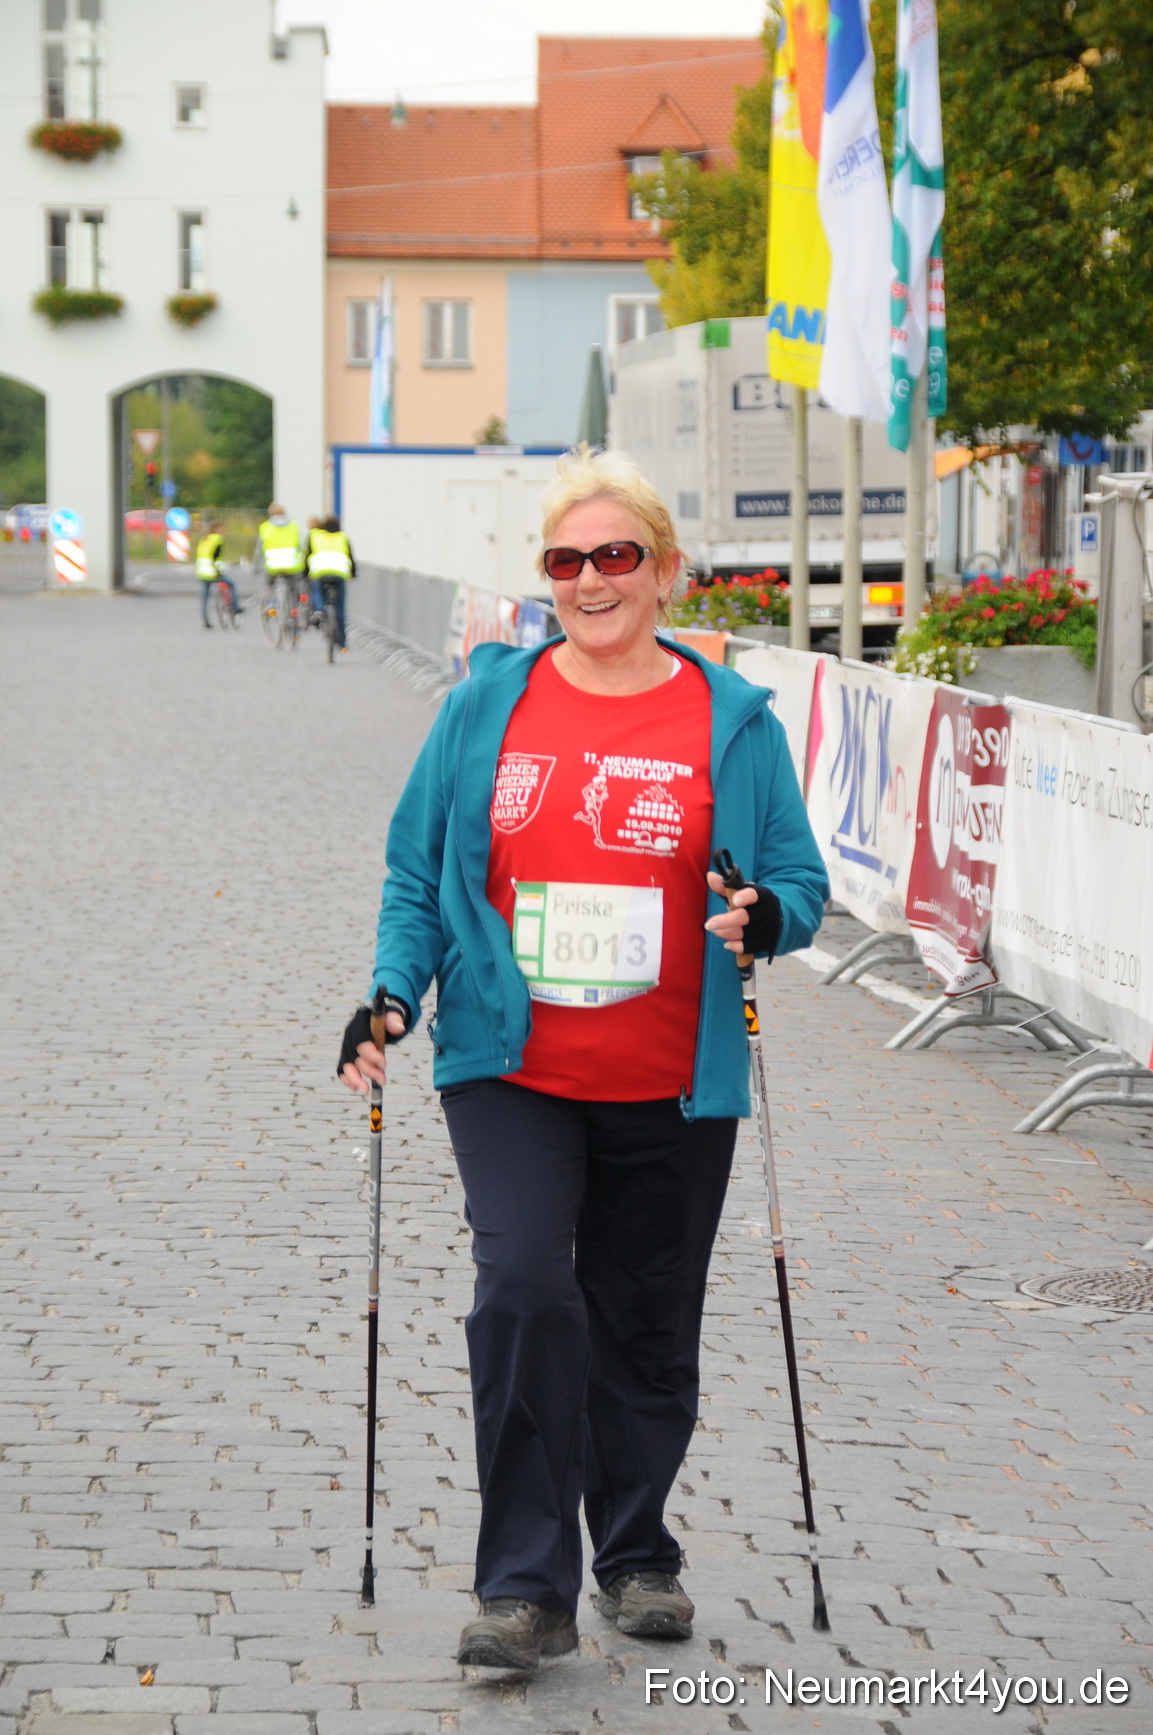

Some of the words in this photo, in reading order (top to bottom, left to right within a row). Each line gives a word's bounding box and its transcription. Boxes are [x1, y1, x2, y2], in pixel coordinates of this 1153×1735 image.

[583, 752, 601, 766] 11.
[603, 755, 694, 779] NEUMARKTER
[598, 764, 675, 784] STADTLAUF
[496, 775, 539, 789] WIEDER
[494, 787, 532, 808] NEU
[494, 806, 528, 821] MARKT
[625, 818, 683, 837] 19.09.2010
[552, 892, 614, 917] Priska
[553, 931, 648, 967] 8013
